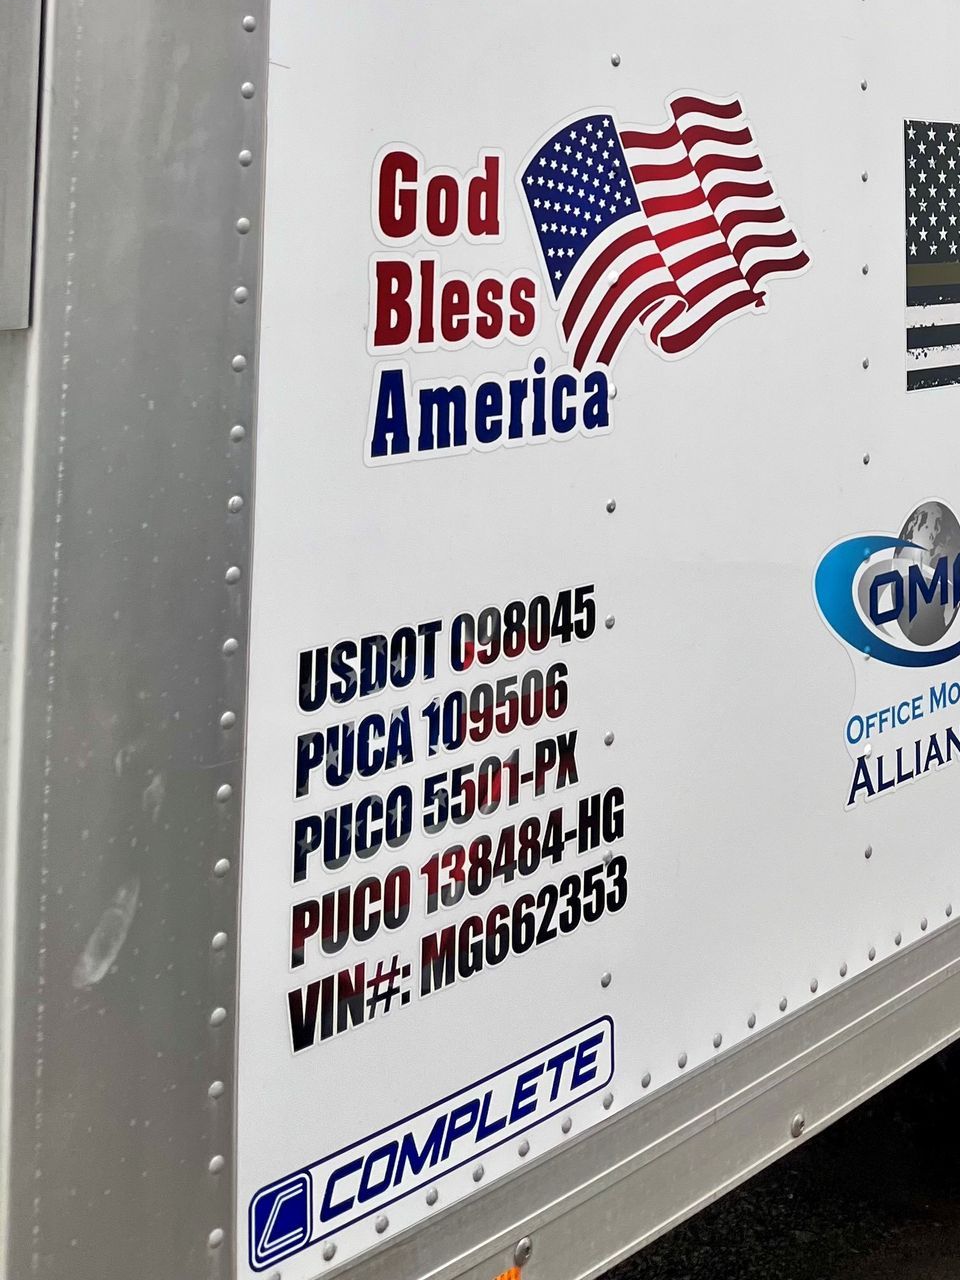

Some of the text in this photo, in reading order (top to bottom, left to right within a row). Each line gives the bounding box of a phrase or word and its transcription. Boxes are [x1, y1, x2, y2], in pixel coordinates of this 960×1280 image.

[379, 151, 500, 238] God
[374, 260, 536, 347] Bless
[370, 357, 610, 458] America
[298, 585, 596, 713] USDOT 098045
[295, 662, 569, 799] PUCA 109506
[846, 694, 924, 745] OFFICE
[293, 730, 579, 884] PUCO 5501-PX
[291, 786, 625, 969] PUCO 138484-HG
[287, 855, 628, 1055] VIN#: MG662353
[319, 1030, 605, 1223] COMPLETE
